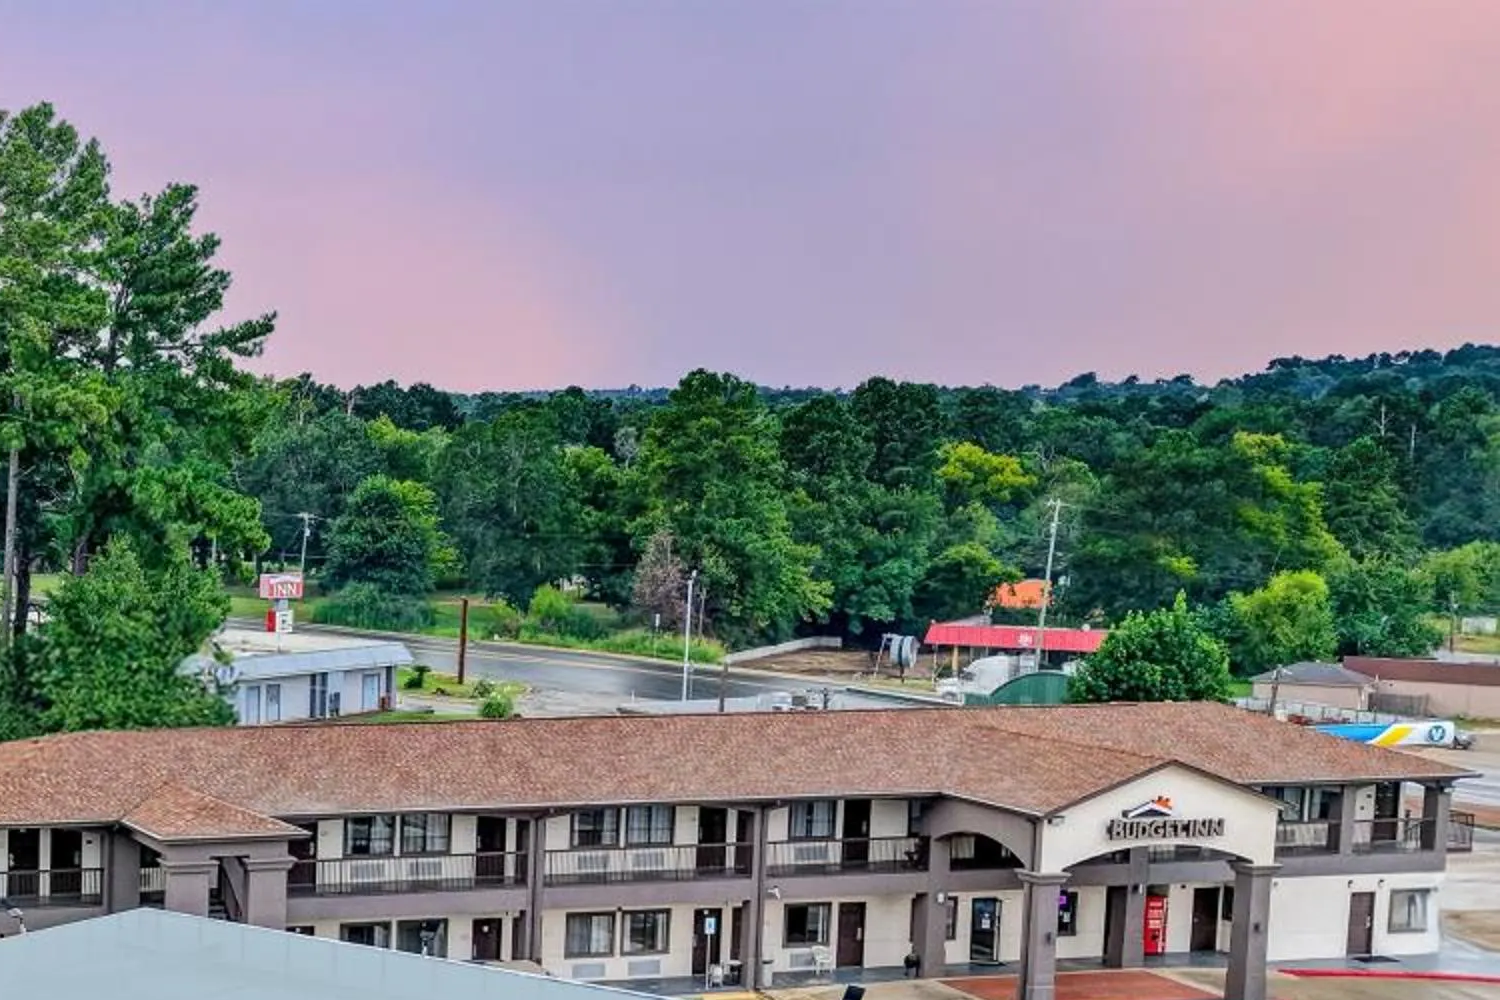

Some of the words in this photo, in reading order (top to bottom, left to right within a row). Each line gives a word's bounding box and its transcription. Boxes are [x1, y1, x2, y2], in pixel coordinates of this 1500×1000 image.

[273, 583, 296, 597] INN
[1107, 819, 1187, 840] BUDGET
[1188, 818, 1225, 837] INN
